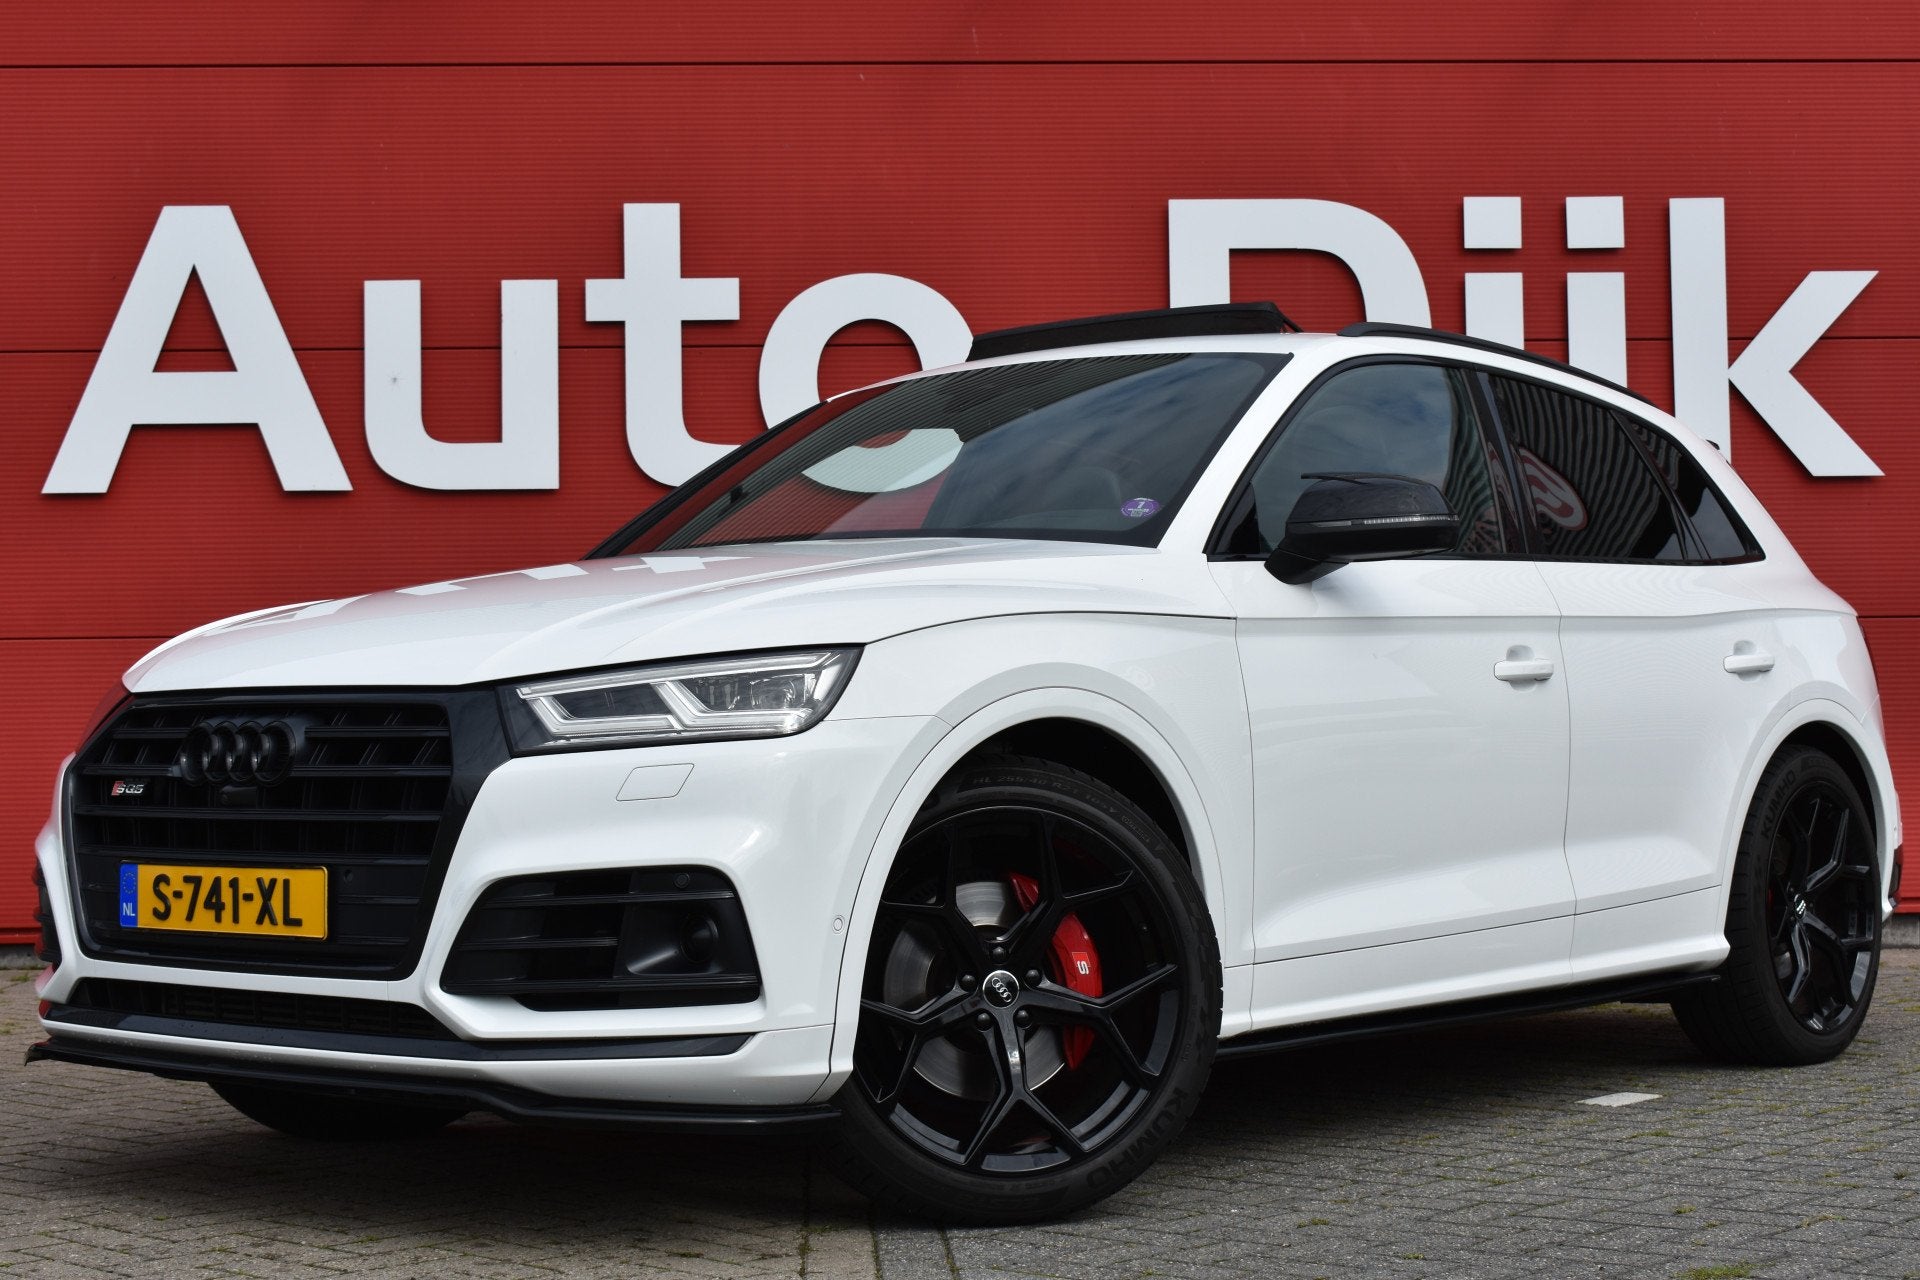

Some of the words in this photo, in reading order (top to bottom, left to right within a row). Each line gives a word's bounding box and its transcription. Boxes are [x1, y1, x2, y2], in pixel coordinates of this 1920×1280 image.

[41, 202, 974, 495] Auto
[114, 782, 145, 795] SQ5
[1761, 770, 1797, 839] KUMHO
[122, 902, 136, 917] NL
[152, 873, 303, 927] S-741-XL
[1076, 960, 1090, 975] S
[1086, 1087, 1189, 1190] KUMHO
